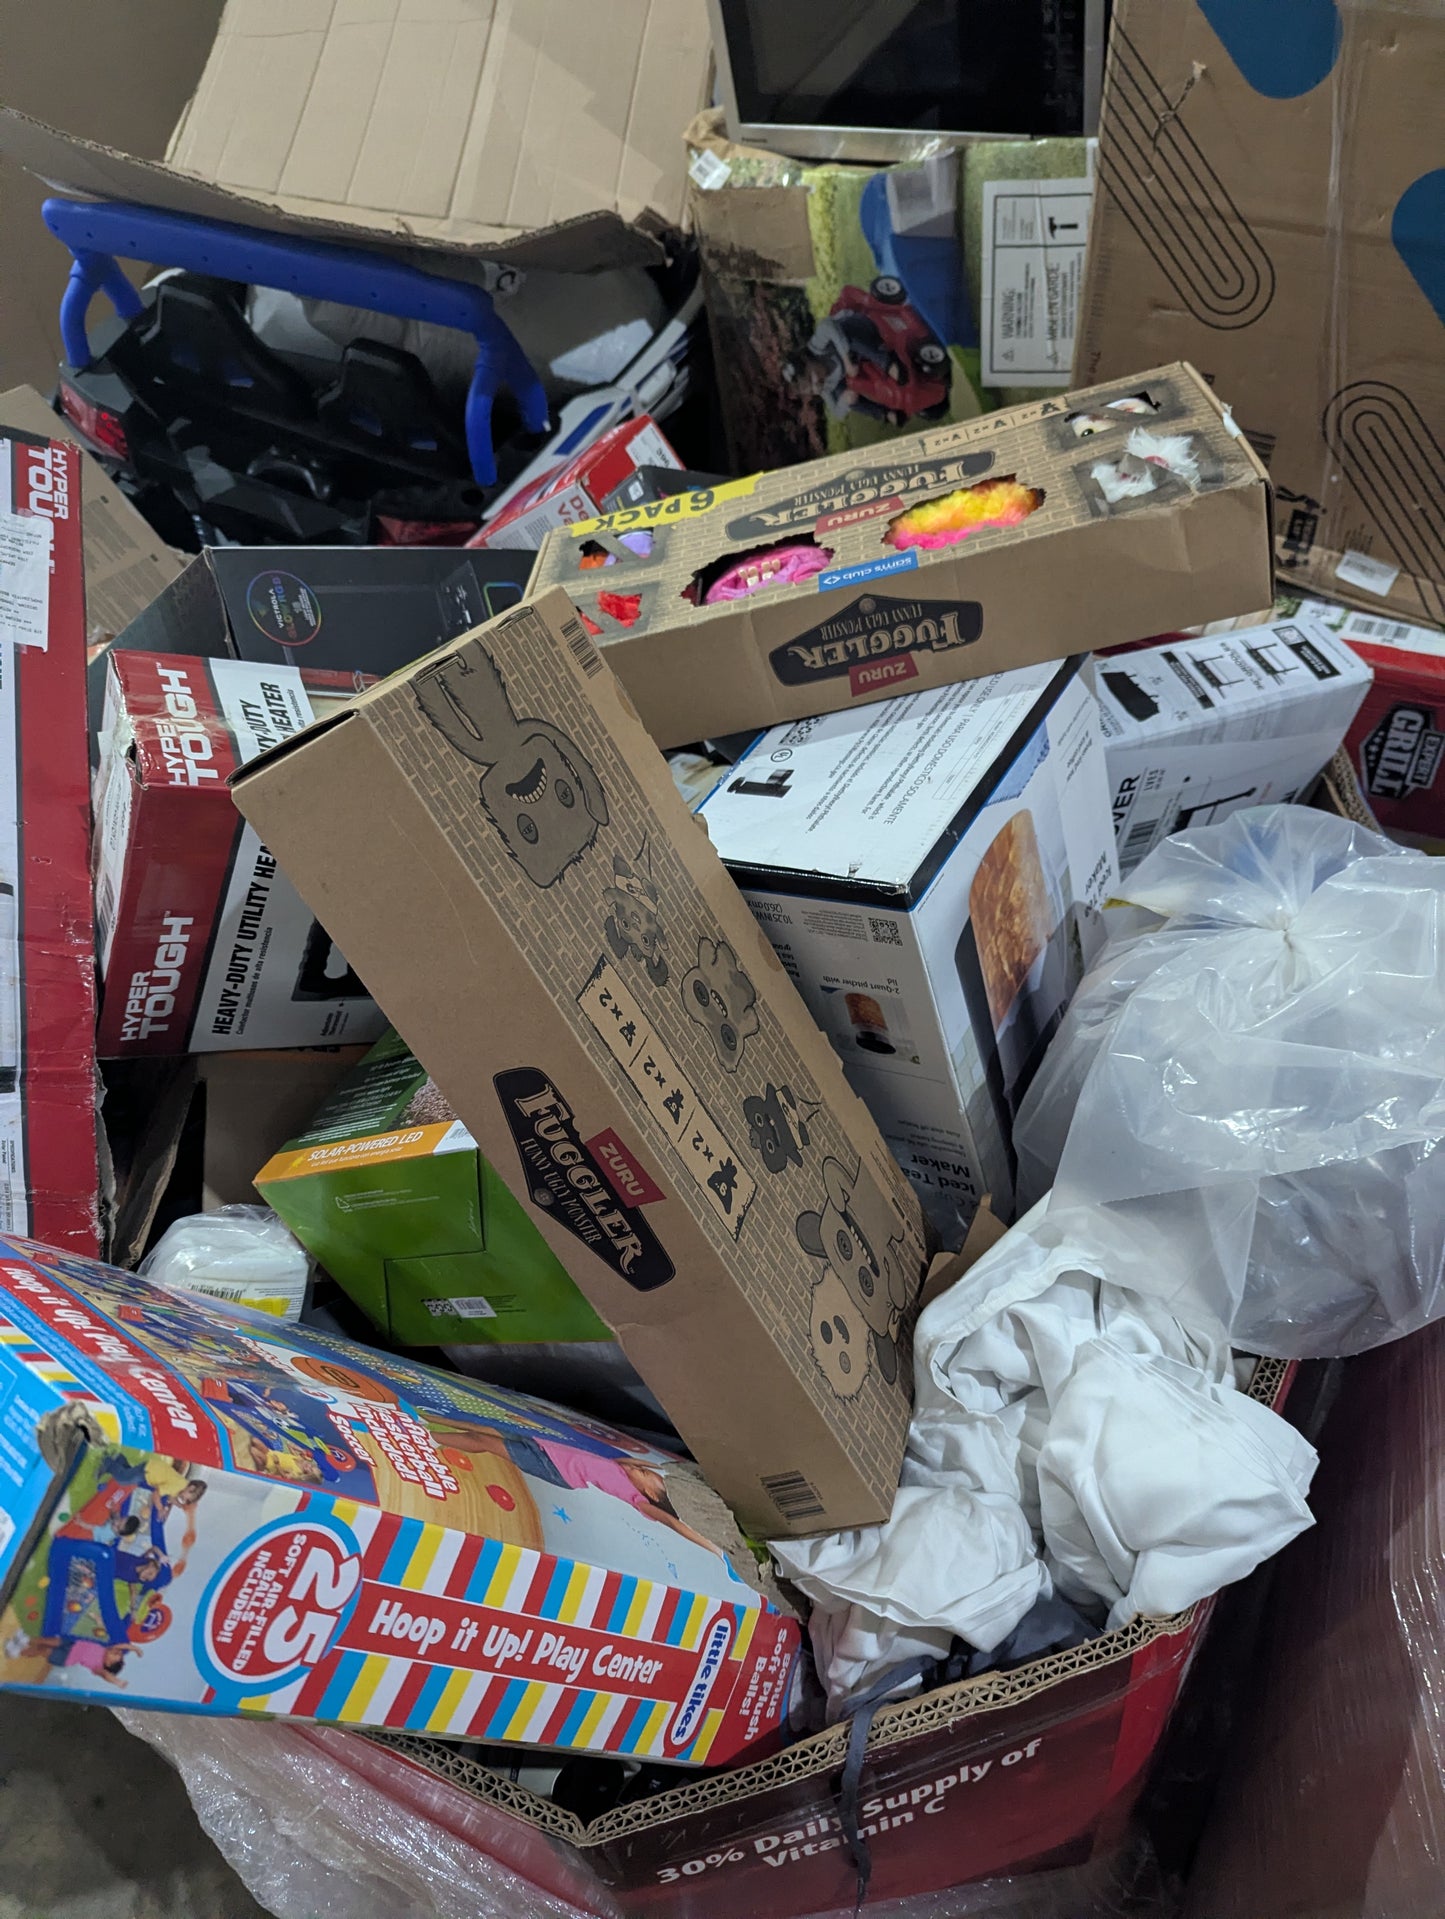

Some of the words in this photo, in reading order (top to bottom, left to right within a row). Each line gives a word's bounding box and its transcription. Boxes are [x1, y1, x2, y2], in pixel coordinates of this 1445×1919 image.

[53, 448, 69, 520] HYPER
[850, 475, 878, 491] UGLY
[883, 464, 919, 484] FUNNY
[28, 447, 56, 574] TOU
[690, 490, 716, 511] 6
[750, 461, 970, 527] FUGGLER
[795, 484, 846, 506] MONSTER
[594, 498, 681, 532] PACK
[827, 502, 892, 527] ZURU
[843, 566, 872, 581] club
[875, 556, 912, 572] sam's
[268, 588, 285, 629] VICTROLA
[866, 613, 890, 628] UGLY
[892, 603, 923, 623] FUNNY
[787, 612, 967, 669] FUGGLER
[821, 619, 863, 641] MONSTER
[858, 662, 907, 684] ZURU
[979, 686, 995, 696] USE
[260, 681, 287, 732] HEATER
[966, 696, 987, 713] ONLY
[157, 667, 219, 787] TOUGH
[939, 735, 957, 748] USO
[951, 718, 971, 734] PARA
[1370, 710, 1425, 799] GRILL
[1411, 734, 1442, 786] EXPERT
[882, 786, 920, 824] SOLAMENTE
[211, 942, 254, 1035] HEAVY-DUTY
[236, 881, 271, 941] UTILITY
[259, 926, 274, 960] resistencia
[138, 915, 194, 1041] TOUGH
[255, 957, 264, 972] alta
[823, 975, 841, 985] with
[887, 977, 898, 985] lid
[842, 978, 868, 990] pitcher
[870, 983, 900, 994] 2-Quart
[119, 971, 151, 1041] HYPER
[307, 1135, 400, 1161] SOLAR-POWERED
[399, 1131, 425, 1144] LED
[514, 1083, 644, 1275] FUGGLER
[599, 1142, 645, 1197] ZURU
[901, 1165, 934, 1187] Tea
[910, 1154, 970, 1179] Maker
[520, 1137, 552, 1174] FUNNY
[543, 1169, 571, 1201] UGLY
[564, 1196, 603, 1245] MONSTER
[937, 1176, 976, 1197] Iced
[2, 1266, 51, 1295] Hoop
[38, 1295, 73, 1311] it
[53, 1307, 107, 1332] Up!
[83, 1331, 142, 1365] Play
[128, 1364, 199, 1440] Center
[328, 1414, 376, 1467] Soccer
[391, 1408, 459, 1492] Inflatable
[278, 1533, 308, 1578] SOFT
[241, 1567, 277, 1622] BALLS
[263, 1546, 362, 1664] 25
[231, 1583, 284, 1673] AIR-FILLED
[368, 1599, 446, 1656] Hoop
[450, 1616, 479, 1653] it
[481, 1621, 526, 1668] Up!
[532, 1640, 589, 1683] Play
[591, 1645, 664, 1687] Center
[700, 1625, 729, 1681] little
[769, 1628, 788, 1675] Soft
[739, 1656, 768, 1716] Balls!
[766, 1653, 792, 1719] Bonus
[674, 1683, 708, 1738] tikes
[744, 1681, 773, 1741] Plush
[656, 1848, 745, 1884] 30%
[862, 1760, 994, 1819] Supply
[1000, 1738, 1043, 1768] of
[925, 1796, 945, 1815] C
